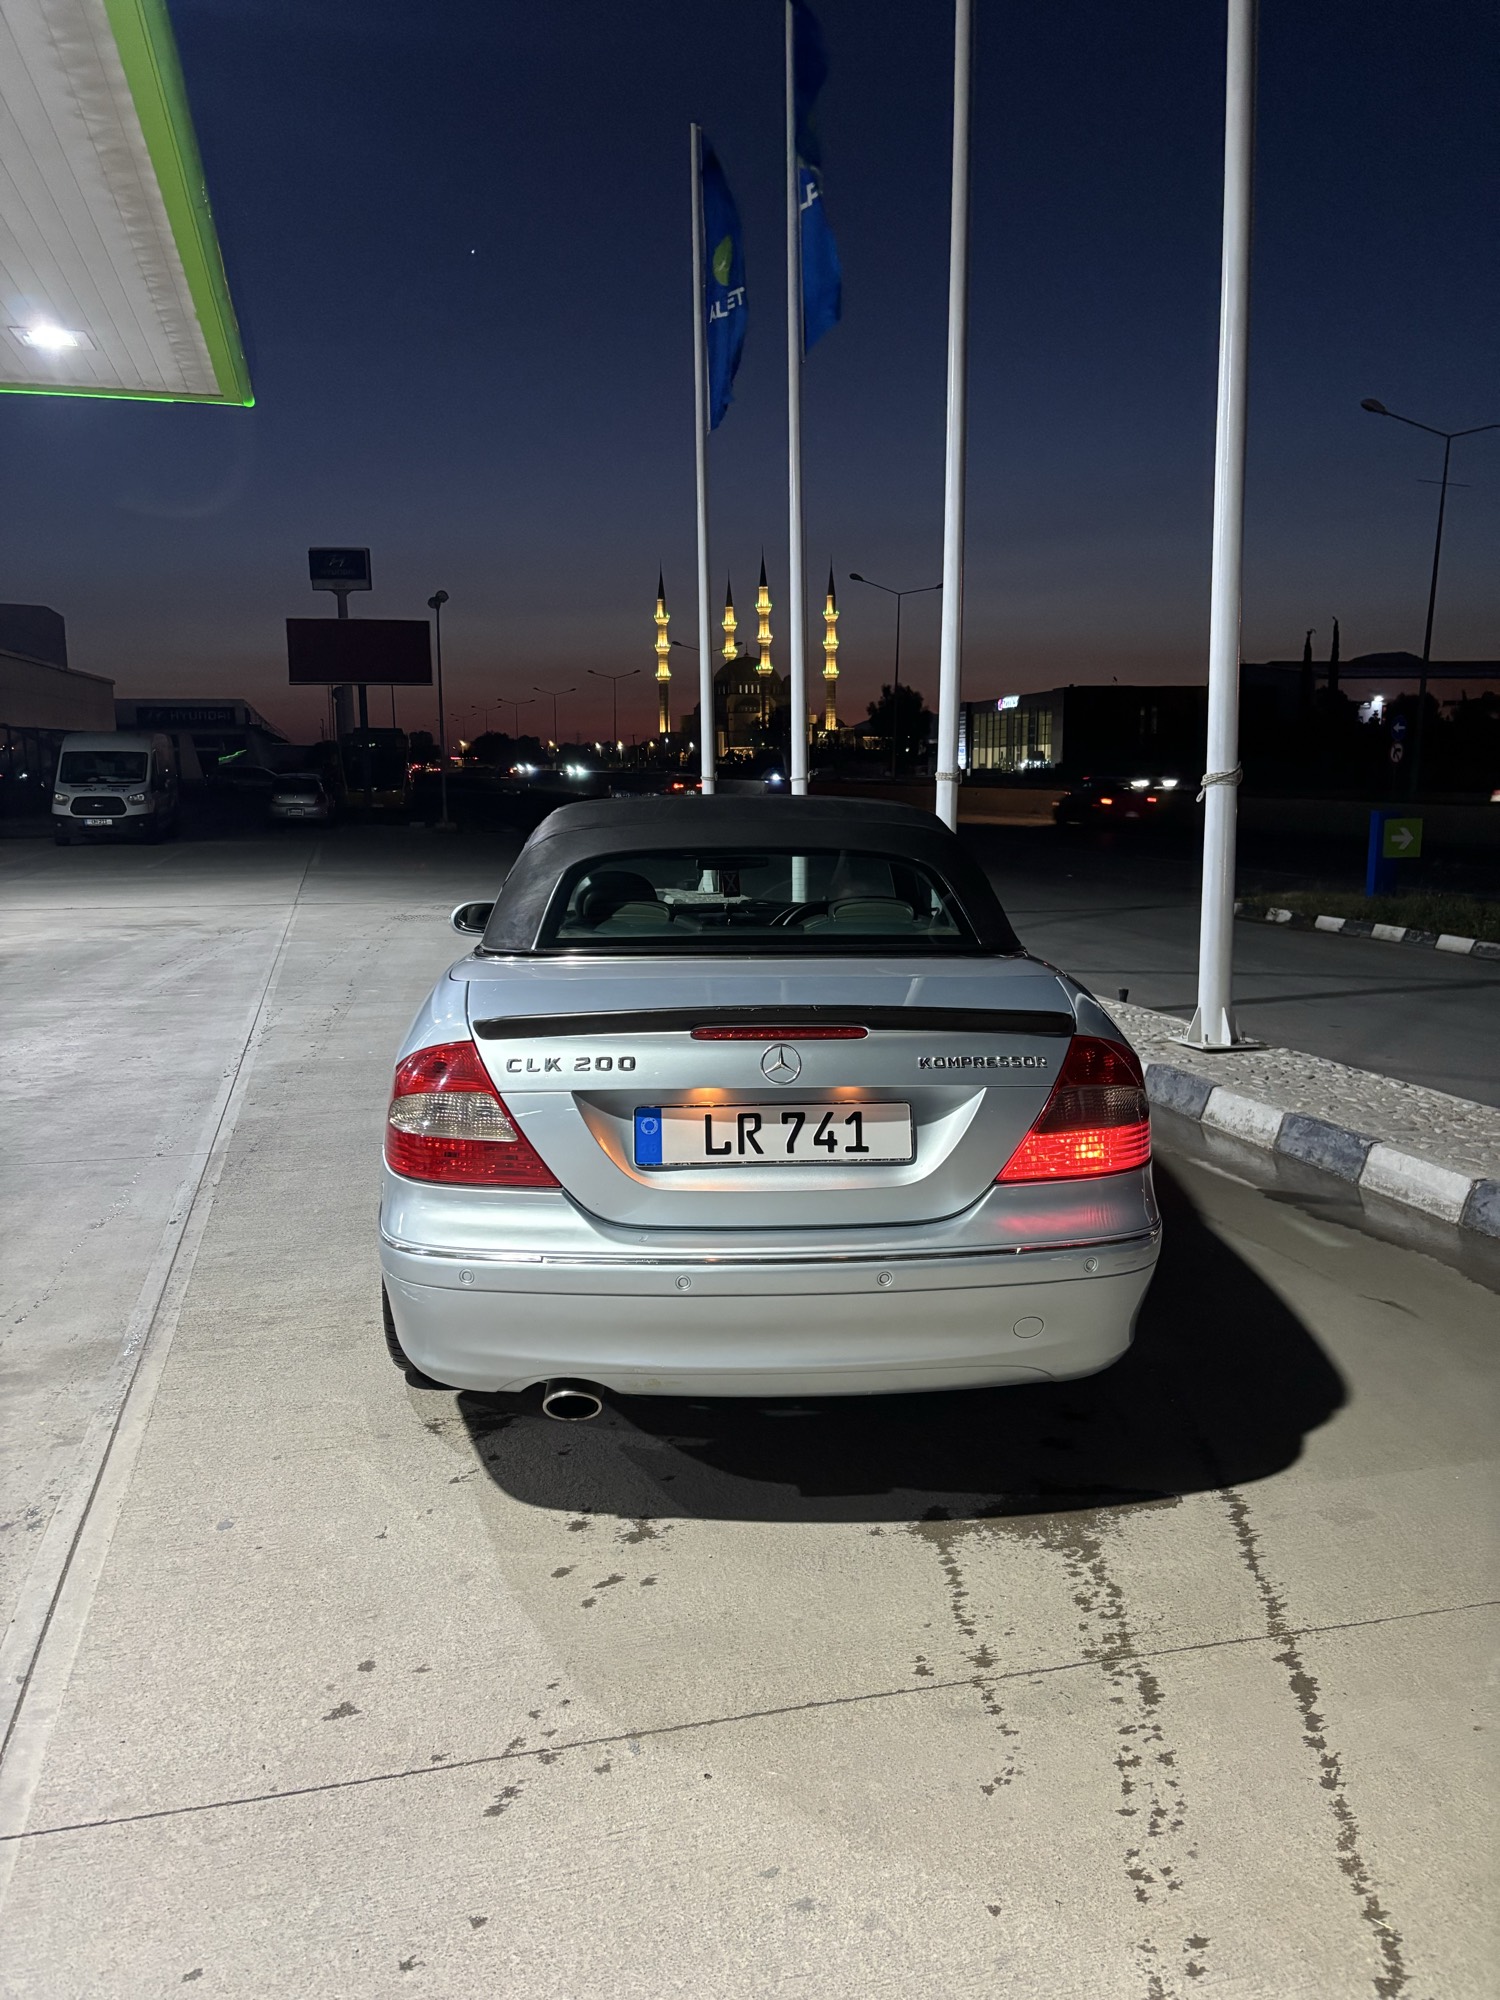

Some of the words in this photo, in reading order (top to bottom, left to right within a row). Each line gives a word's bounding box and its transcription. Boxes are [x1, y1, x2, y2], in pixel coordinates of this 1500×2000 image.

[170, 711, 230, 721] HYUNDAI
[506, 1058, 562, 1072] CLK
[573, 1056, 636, 1071] 200
[917, 1056, 1048, 1069] KOMPRESSOR
[704, 1112, 764, 1155] LR
[781, 1111, 869, 1154] 741
